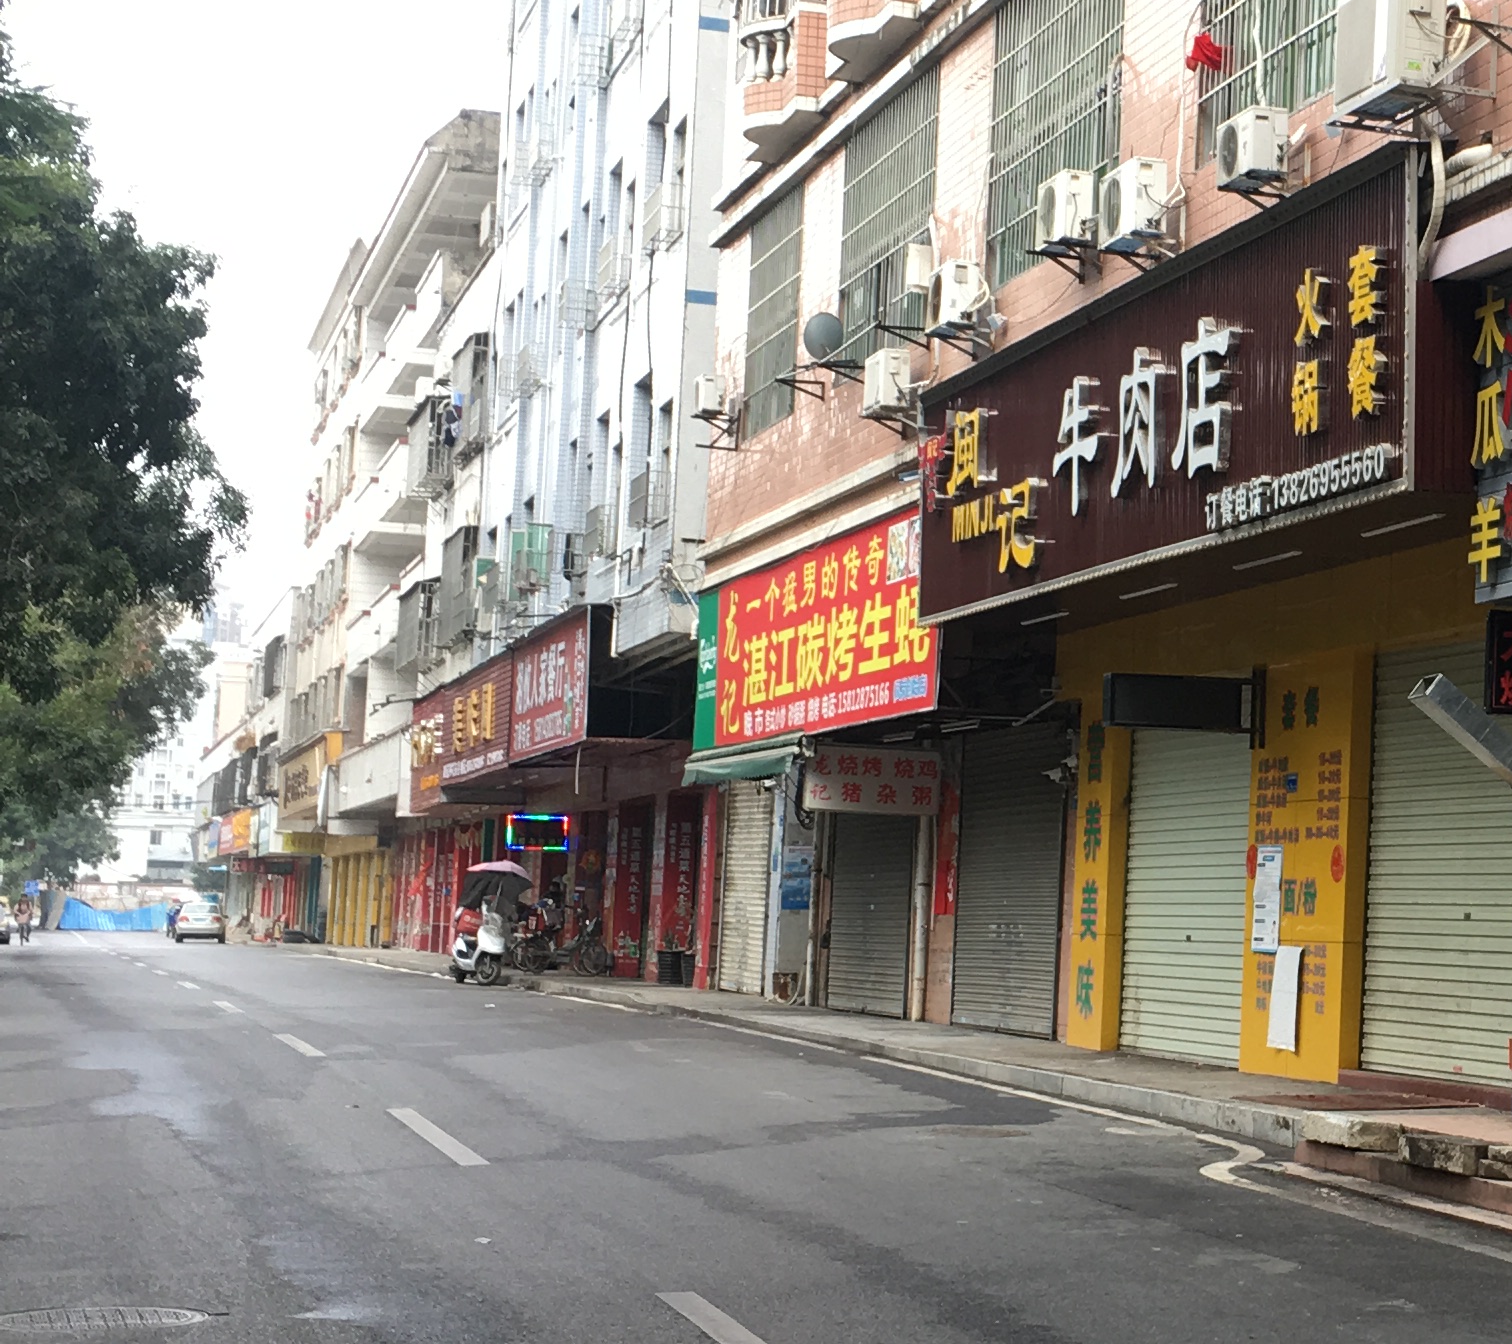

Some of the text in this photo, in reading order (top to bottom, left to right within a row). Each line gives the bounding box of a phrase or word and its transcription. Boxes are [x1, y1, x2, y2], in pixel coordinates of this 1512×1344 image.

[1052, 317, 1241, 518] 牛肉店
[1291, 267, 1331, 438] 火锅
[1347, 244, 1384, 421] 套餐
[1468, 285, 1507, 585] 木瓜羊
[742, 585, 932, 707] 湛江碳烤生蚝
[746, 534, 886, 622] 一个猛男的传奇
[838, 754, 938, 780] 烧烤 烧鸡
[841, 782, 933, 806] 猪杂粥
[1074, 720, 1106, 1023] 营养美味
